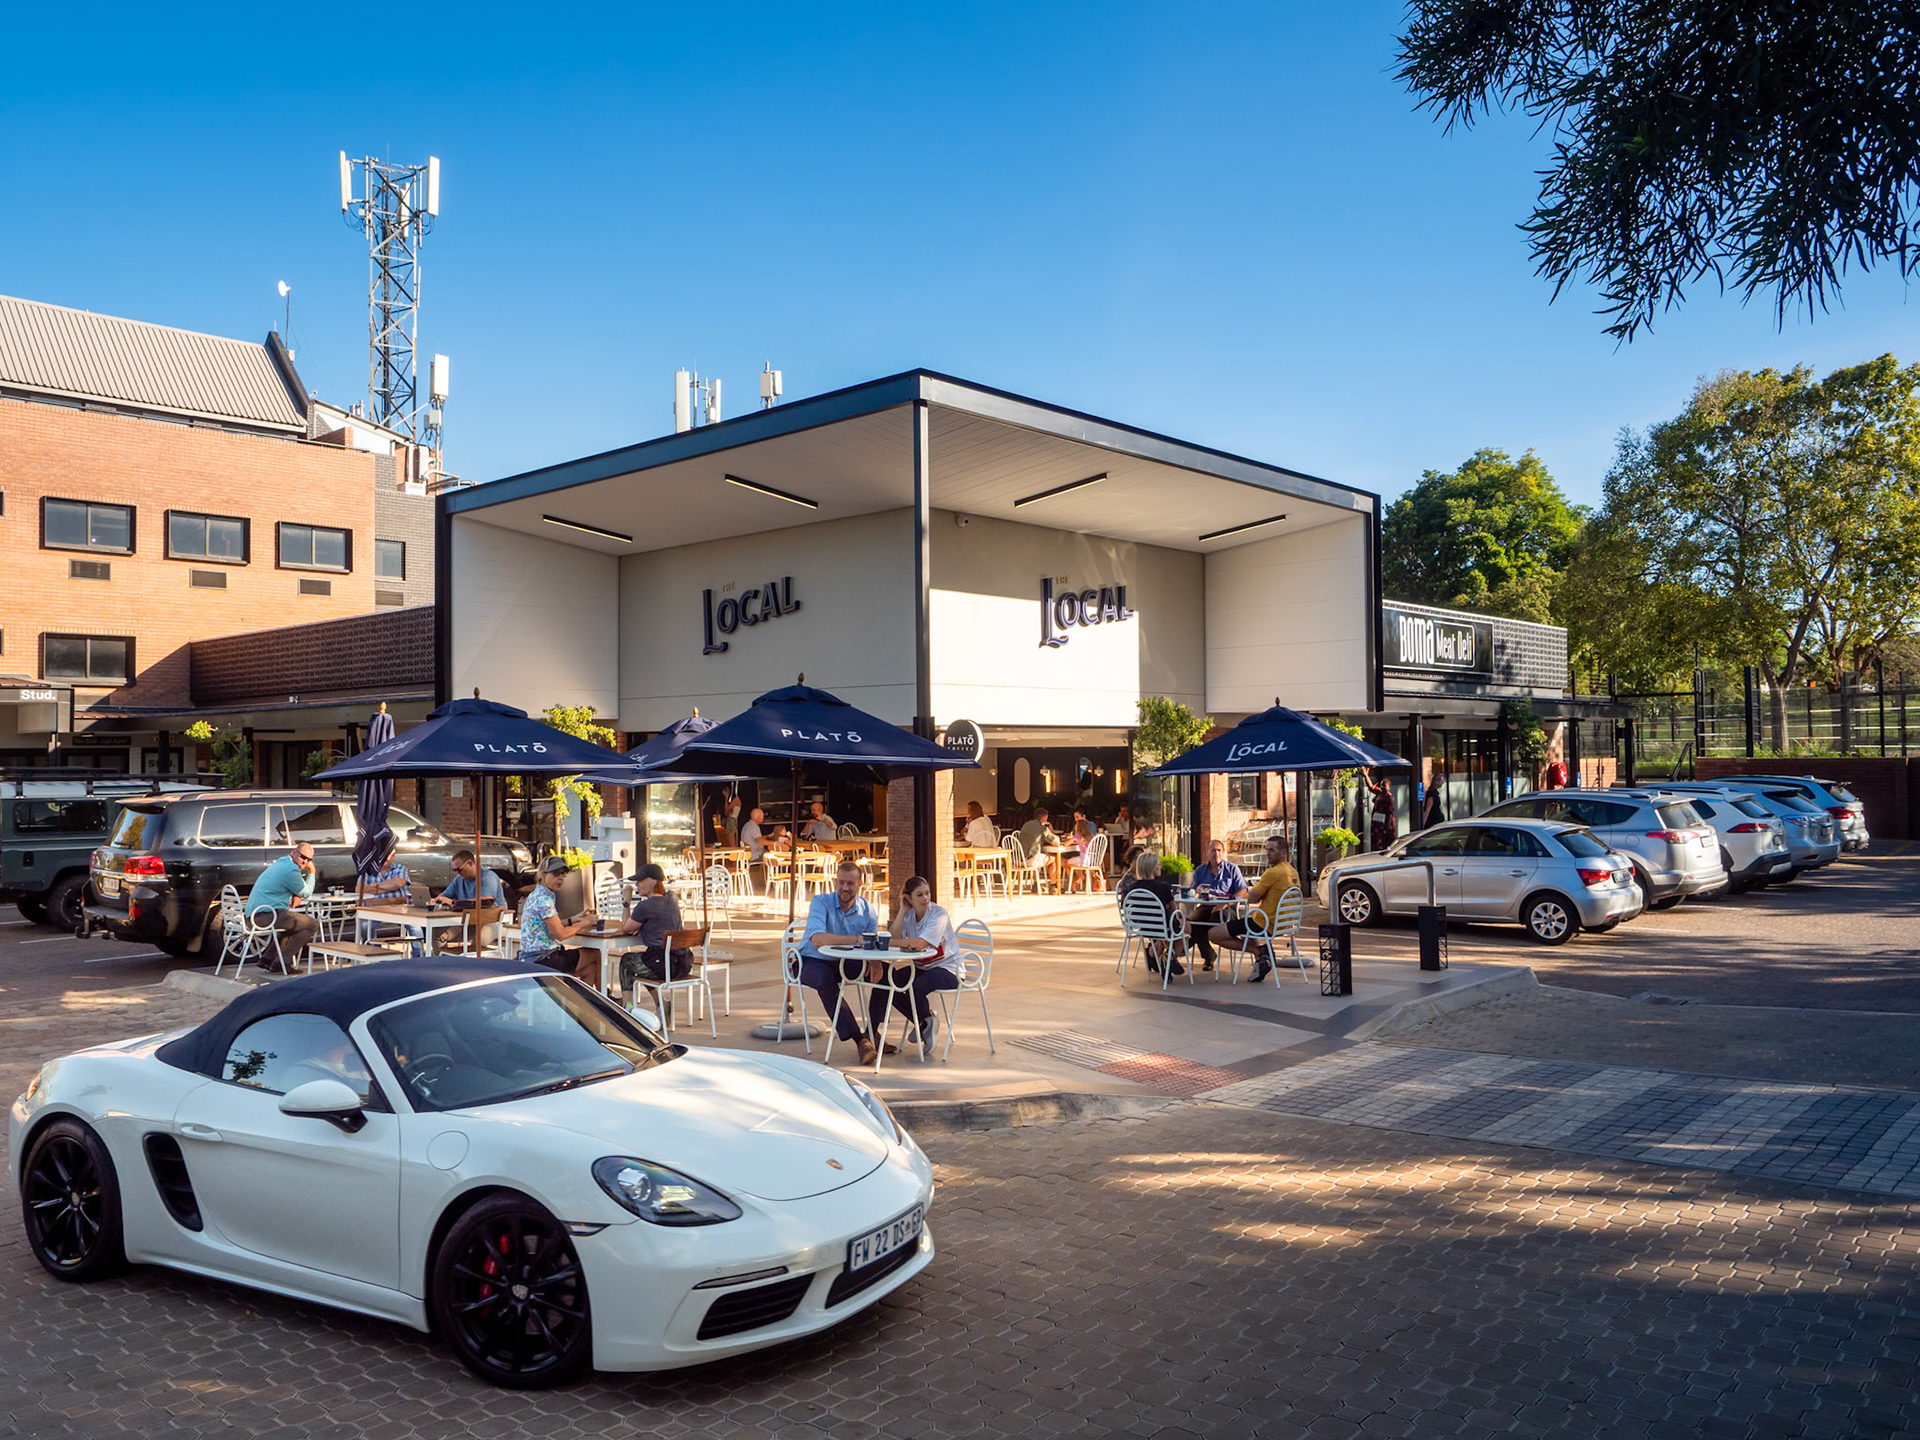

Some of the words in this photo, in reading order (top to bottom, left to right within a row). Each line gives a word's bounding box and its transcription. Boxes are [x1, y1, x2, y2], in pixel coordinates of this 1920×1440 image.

[1436, 628, 1456, 659] Meat
[1457, 630, 1472, 661] Deli
[20, 689, 57, 700] Stud.
[854, 1239, 870, 1266] FW
[875, 1230, 888, 1256] 22
